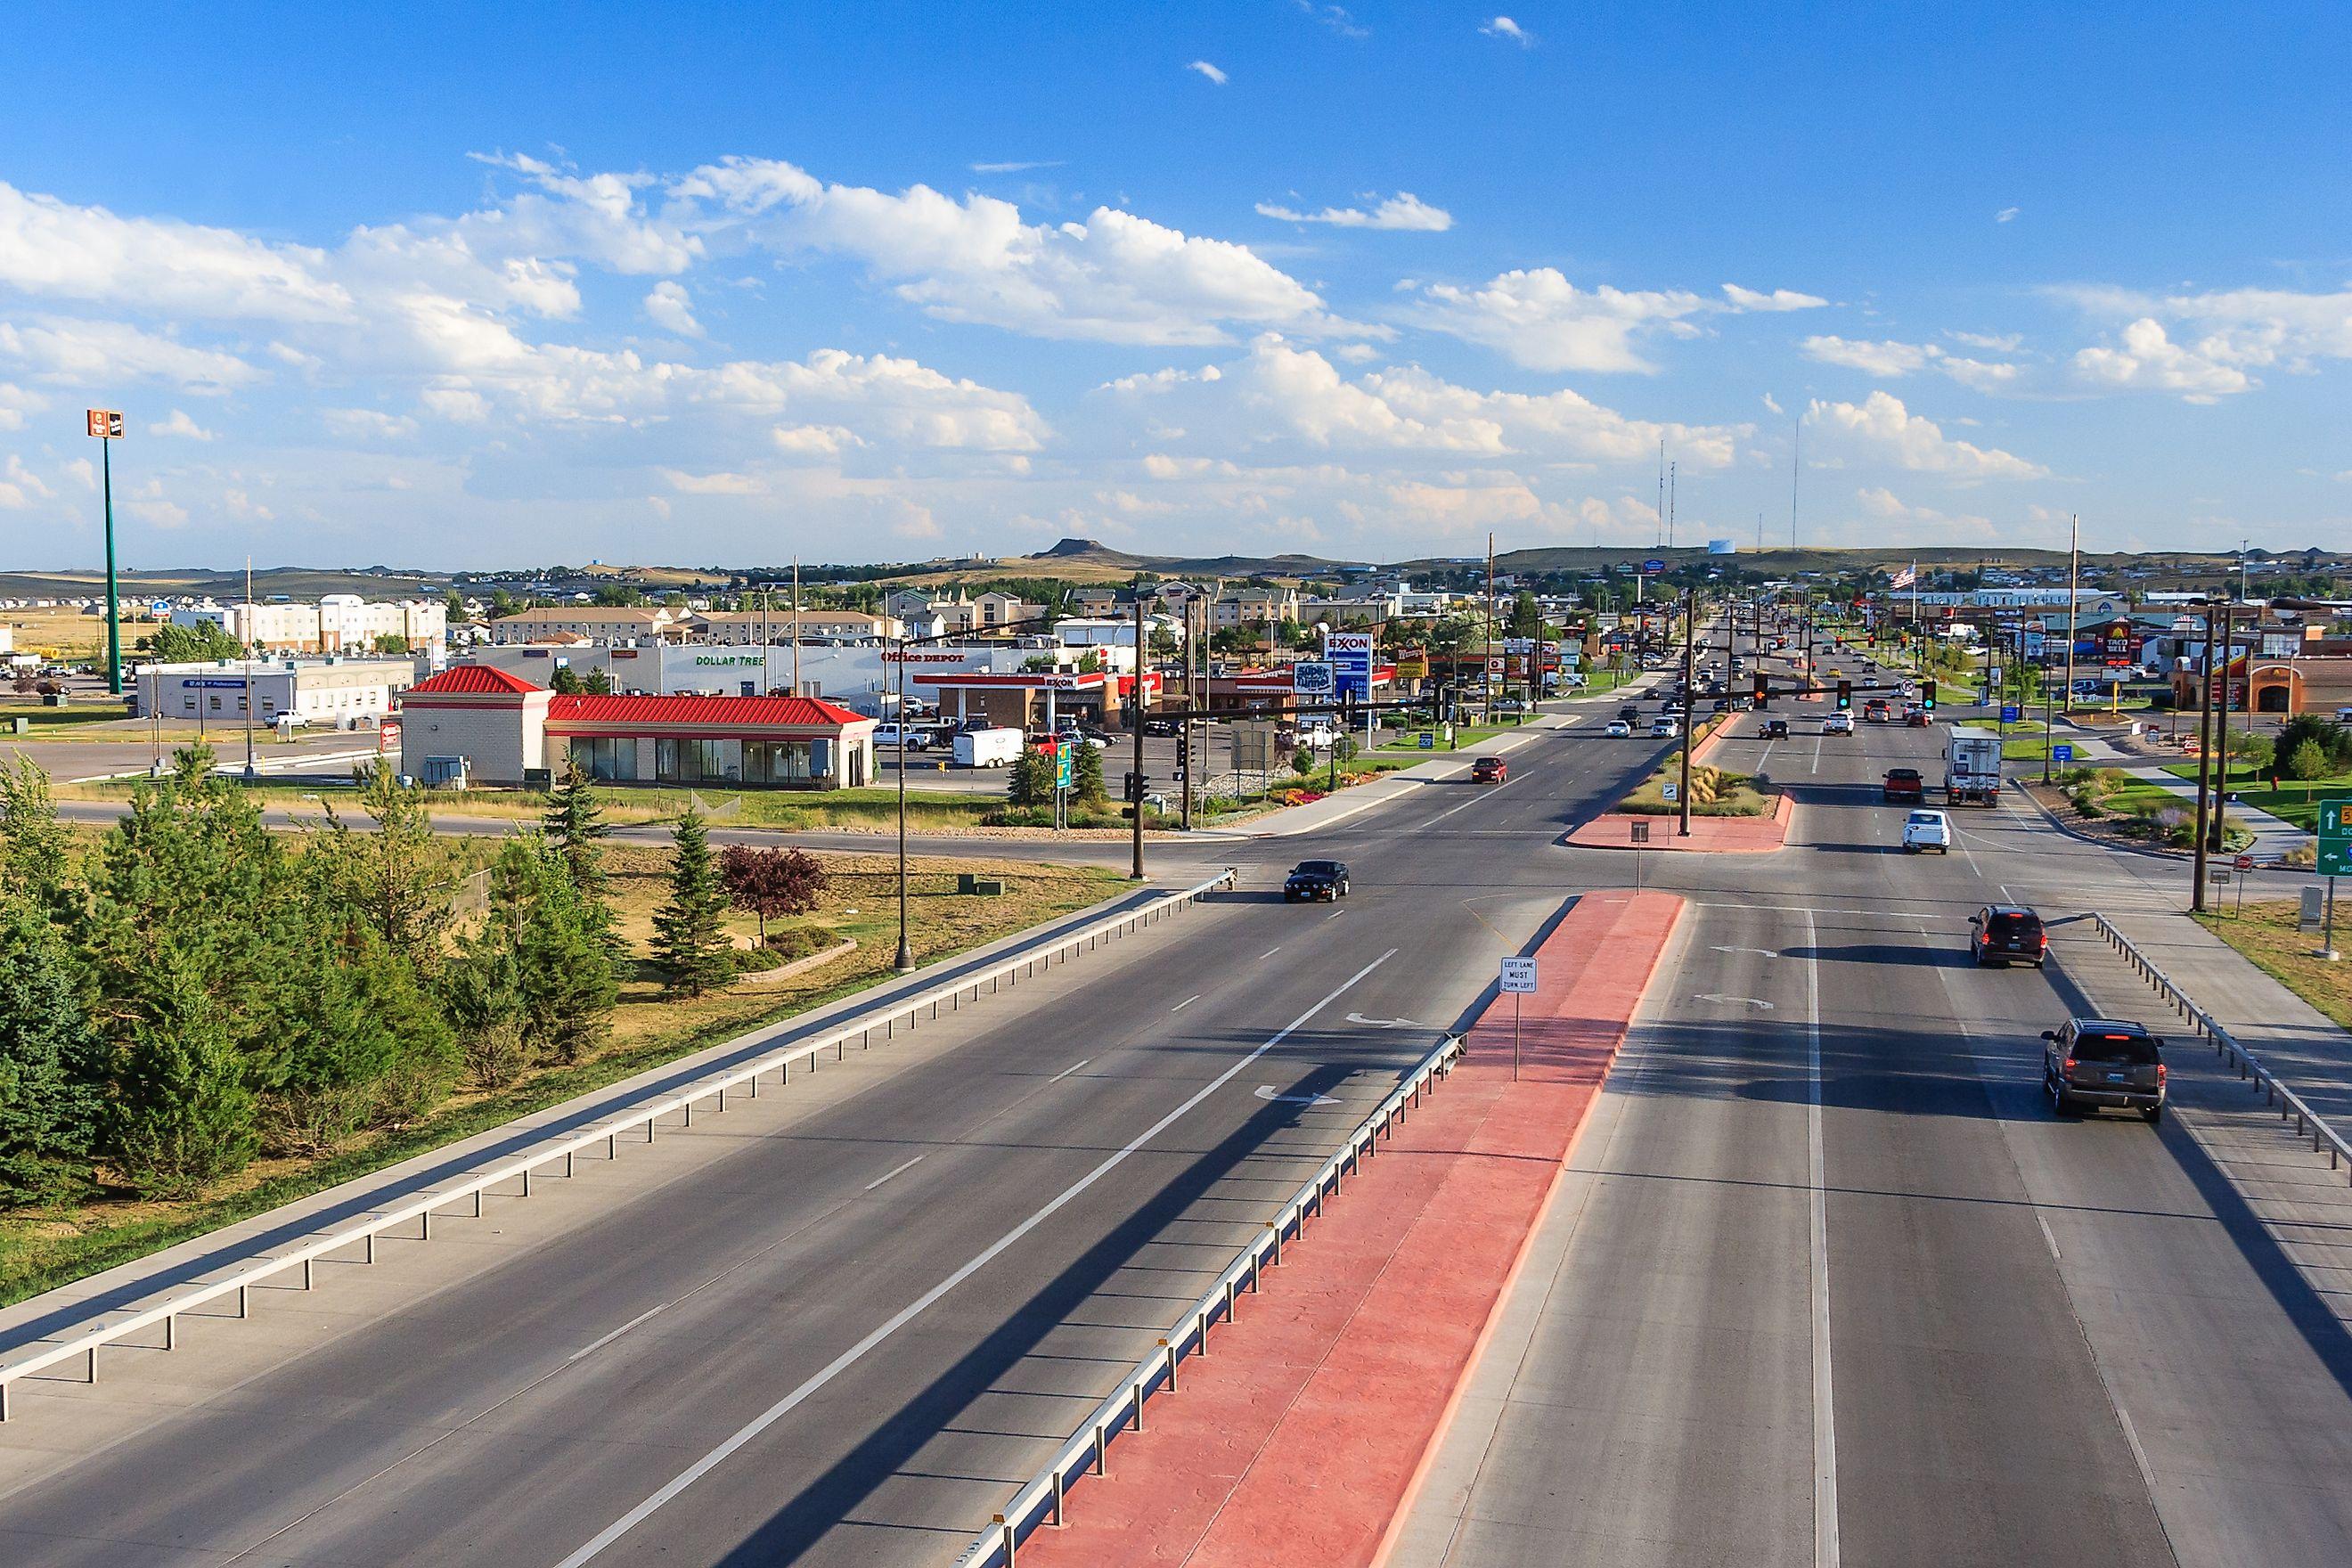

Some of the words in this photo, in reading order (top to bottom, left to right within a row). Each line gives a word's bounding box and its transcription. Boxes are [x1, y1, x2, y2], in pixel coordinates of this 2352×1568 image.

[1328, 637, 1368, 651] EXXON
[880, 652, 922, 662] Office
[923, 654, 965, 663] DEPOT
[2234, 648, 2240, 656] J
[696, 657, 736, 666] DOLLAR
[739, 657, 765, 666] TREE
[1046, 677, 1074, 689] EXXON
